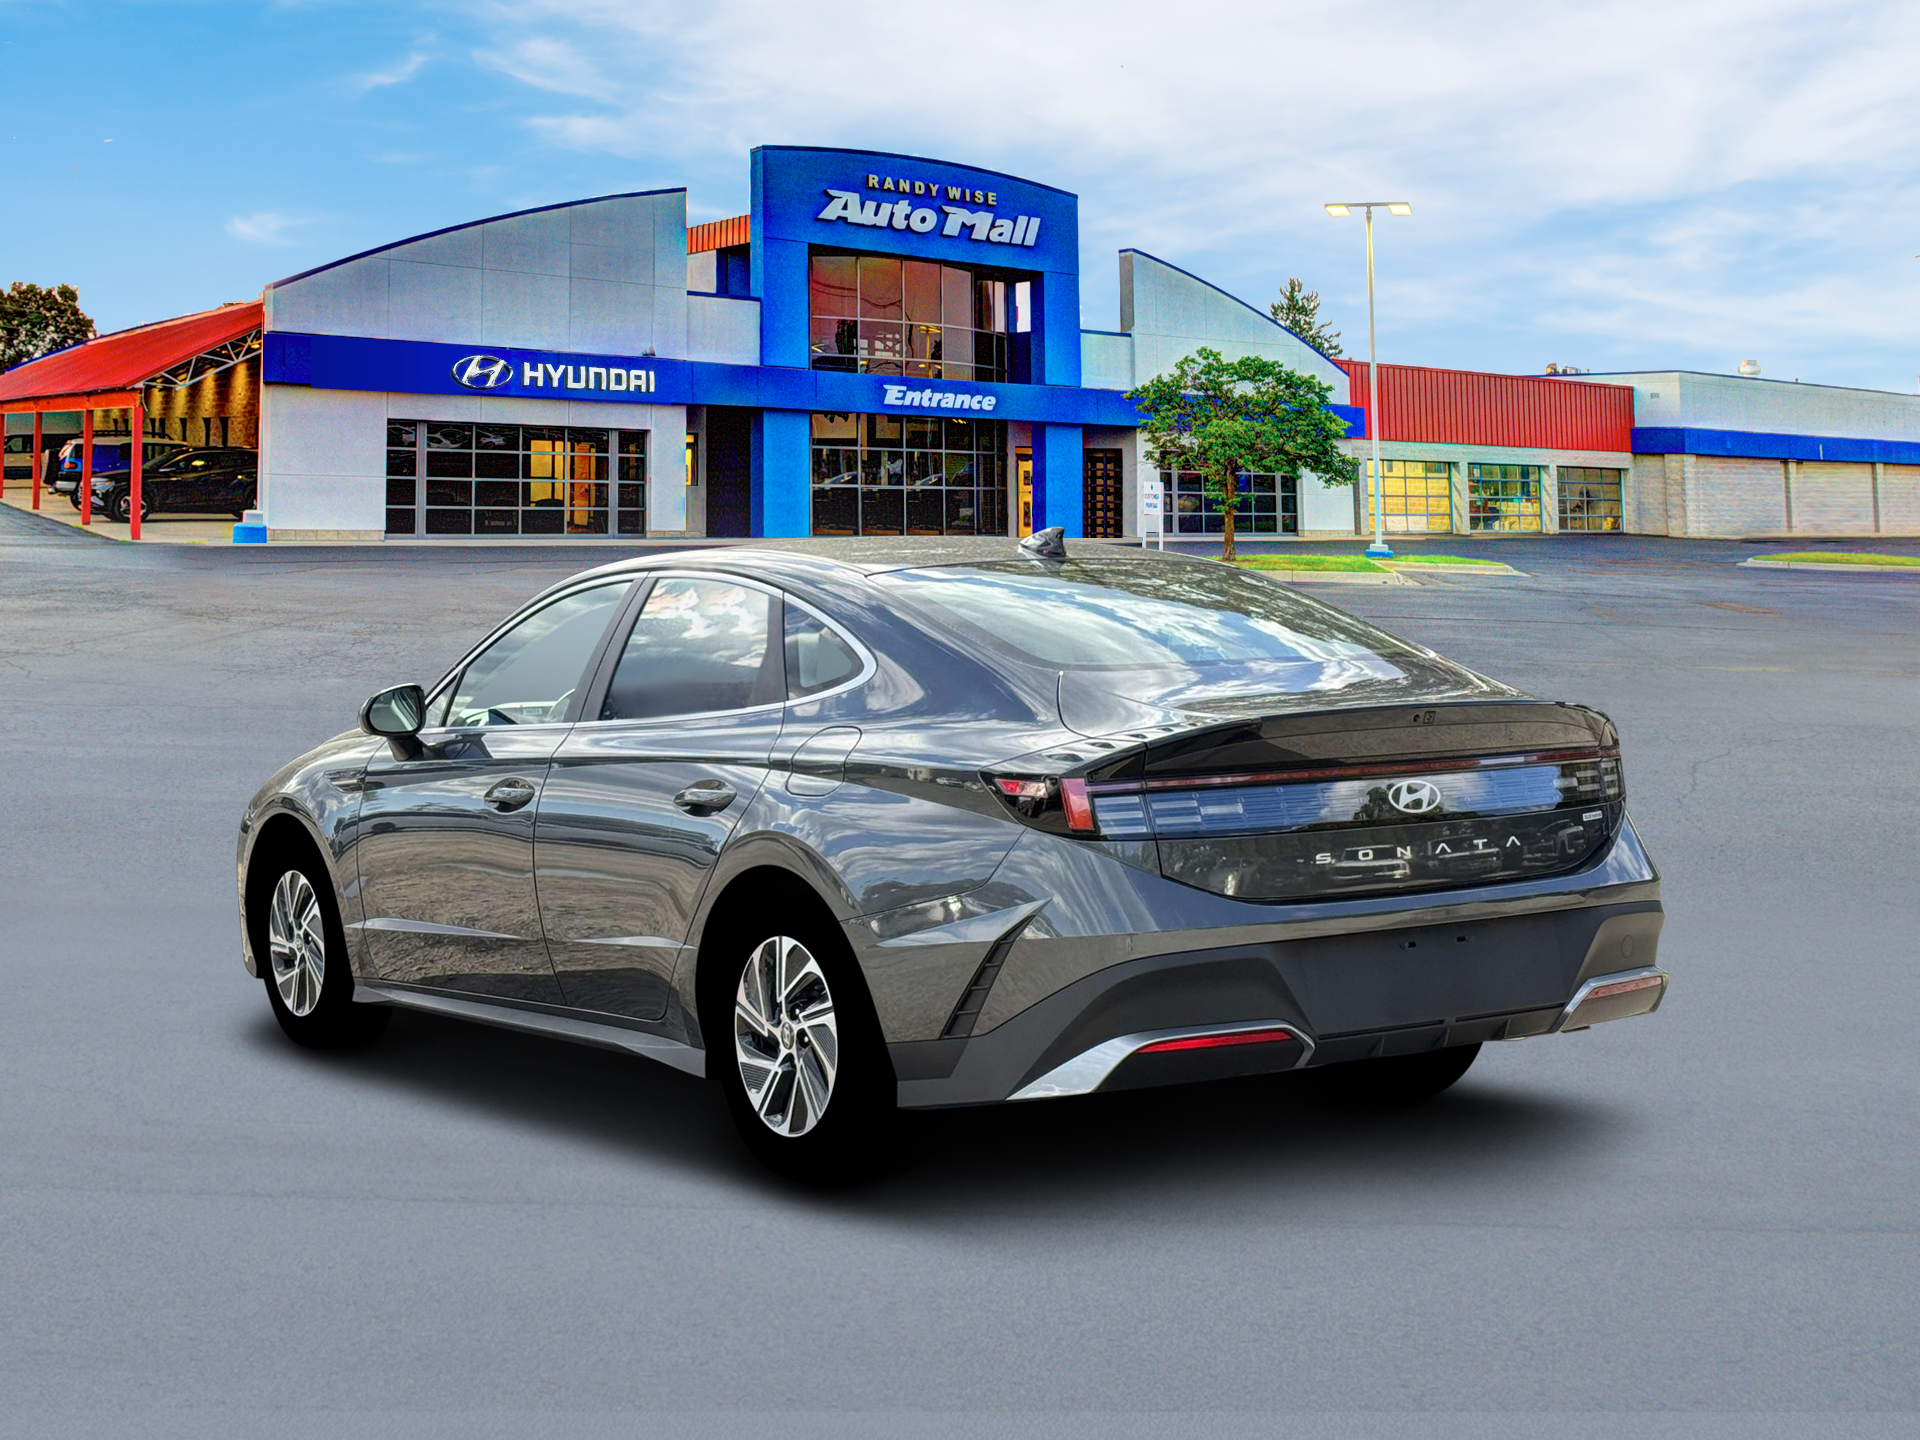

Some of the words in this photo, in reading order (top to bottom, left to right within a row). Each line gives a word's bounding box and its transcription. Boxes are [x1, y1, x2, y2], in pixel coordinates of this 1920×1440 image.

[867, 173, 940, 197] RANDY
[946, 185, 998, 206] WISE
[816, 188, 938, 233] Auto
[940, 205, 1042, 247] Mall
[522, 361, 656, 393] HYUNDAI
[882, 384, 997, 411] Entrance
[1314, 834, 1522, 865] SONATA
